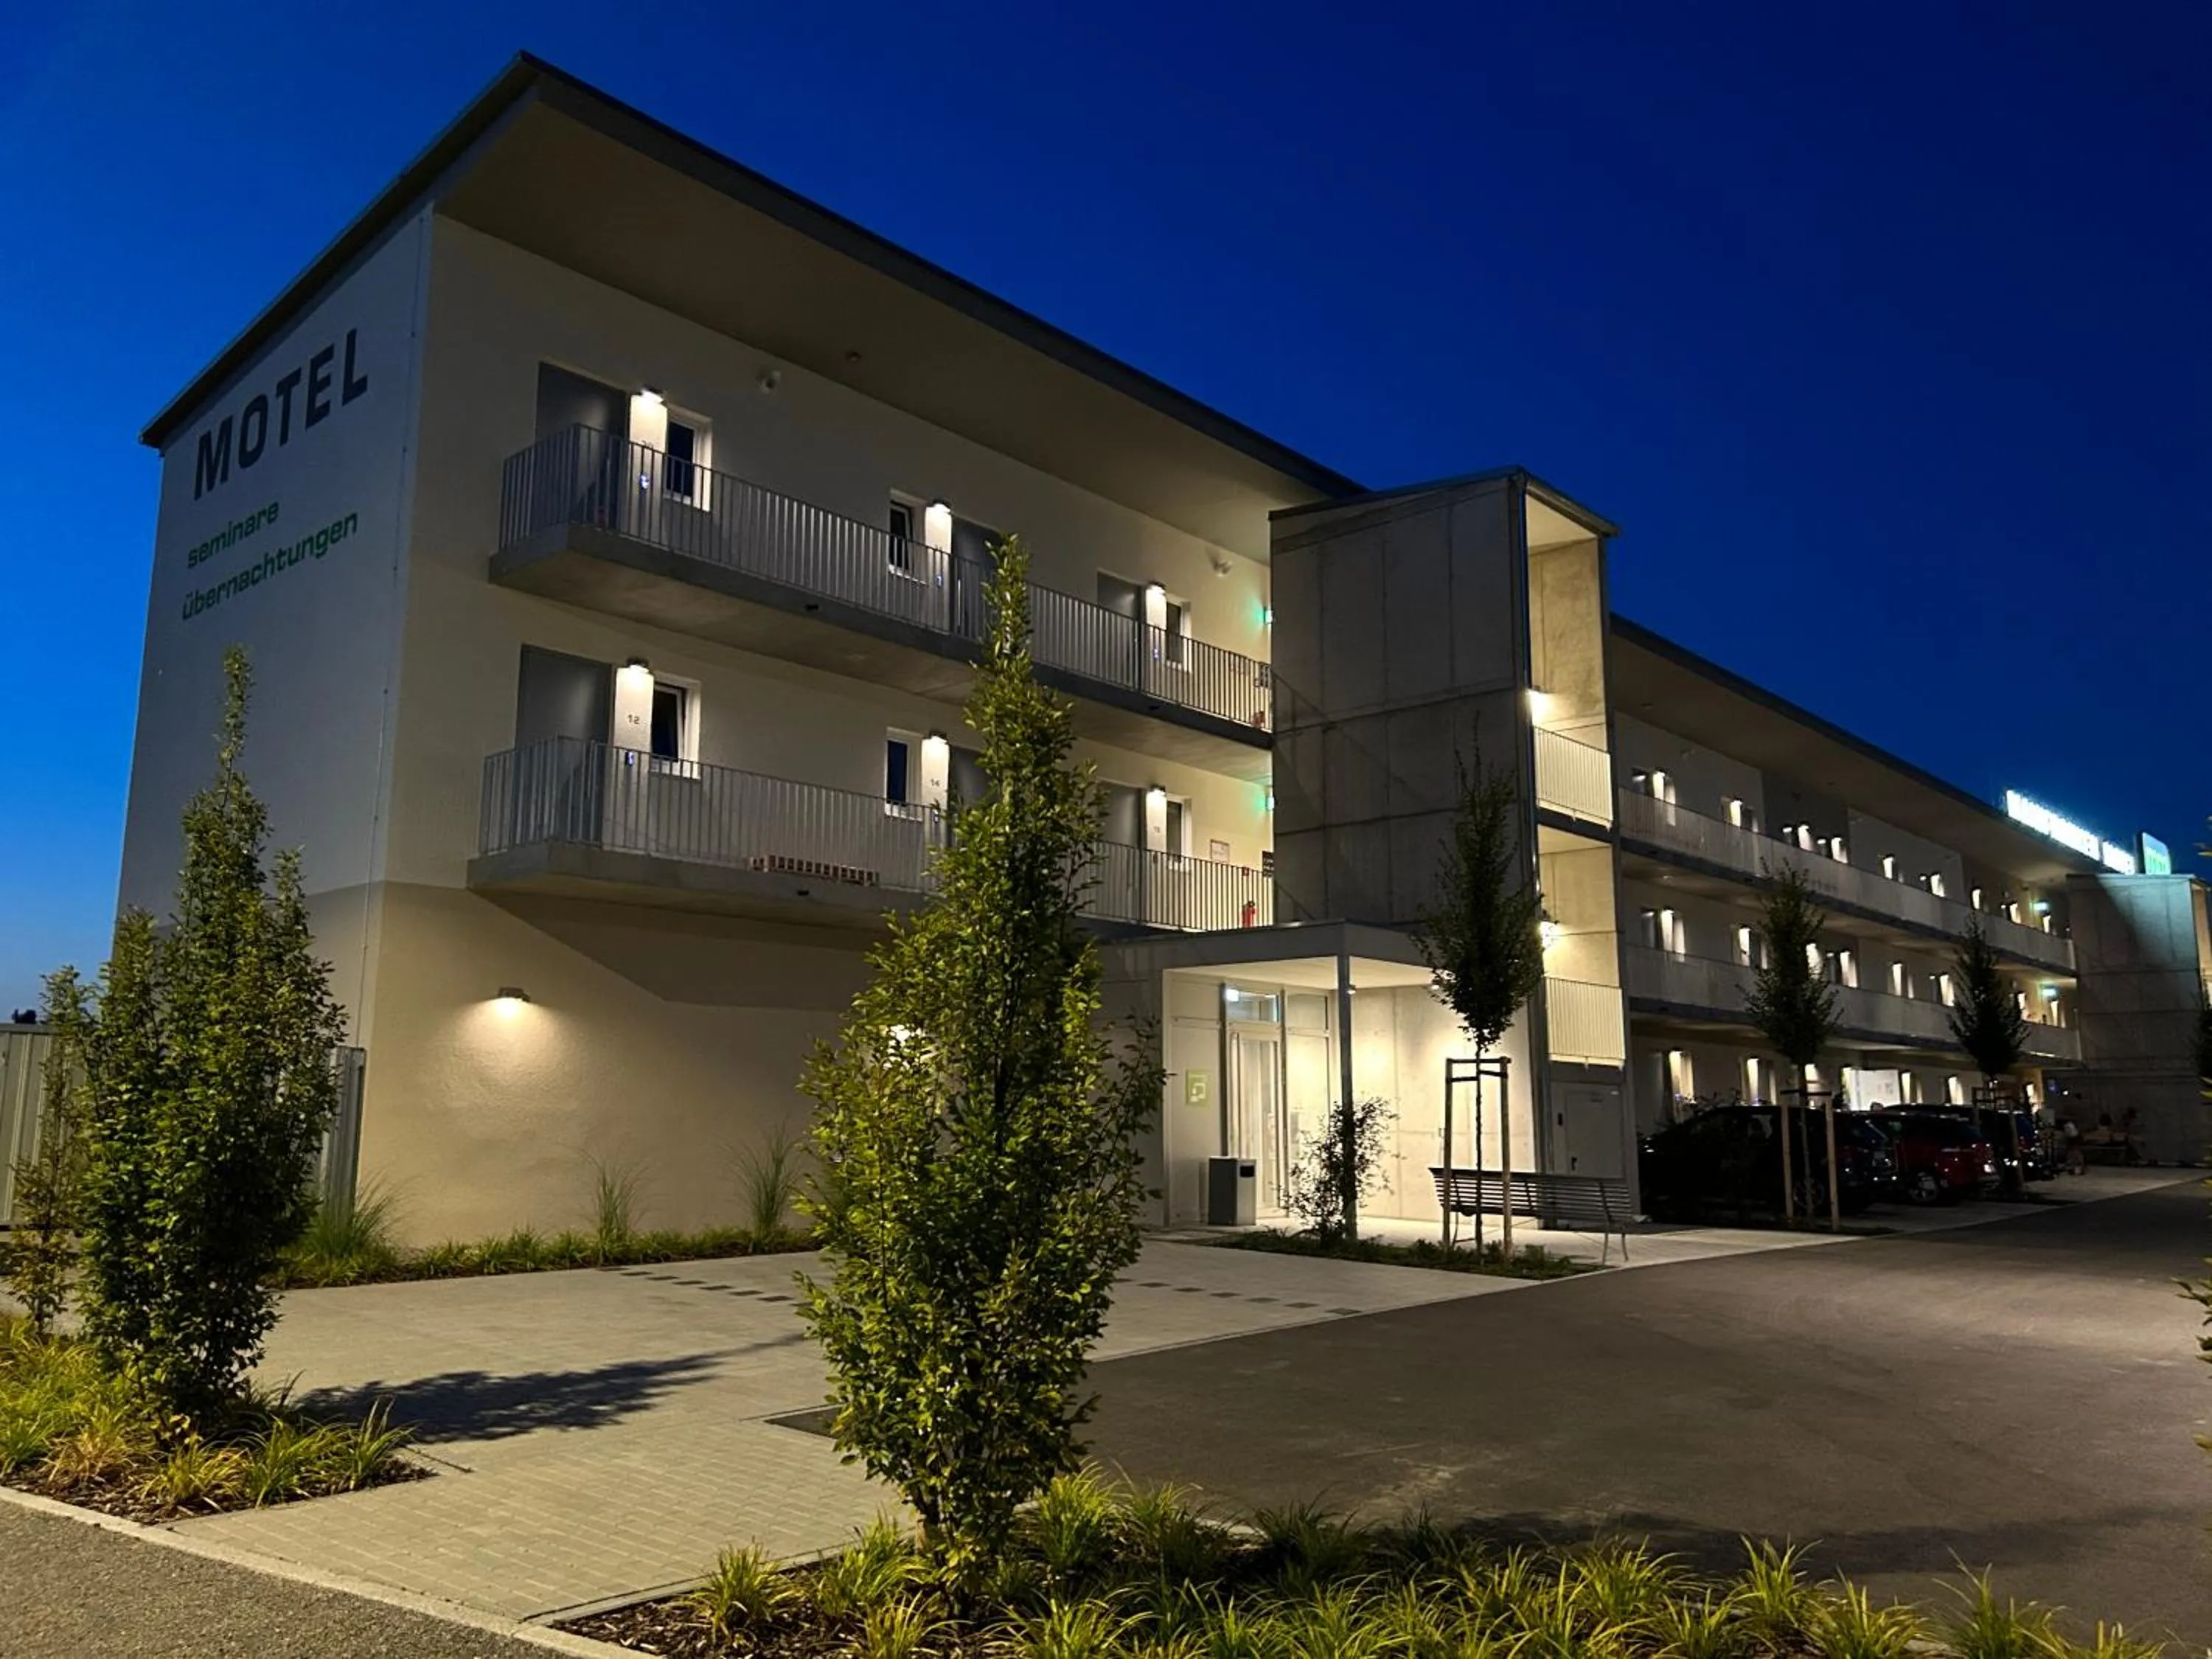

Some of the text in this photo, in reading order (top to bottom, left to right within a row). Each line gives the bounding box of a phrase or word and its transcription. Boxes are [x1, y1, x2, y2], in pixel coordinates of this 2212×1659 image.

[194, 327, 368, 501] MOTEL
[181, 512, 358, 621] übernachtungen
[187, 501, 280, 569] seminare
[627, 714, 641, 725] 12
